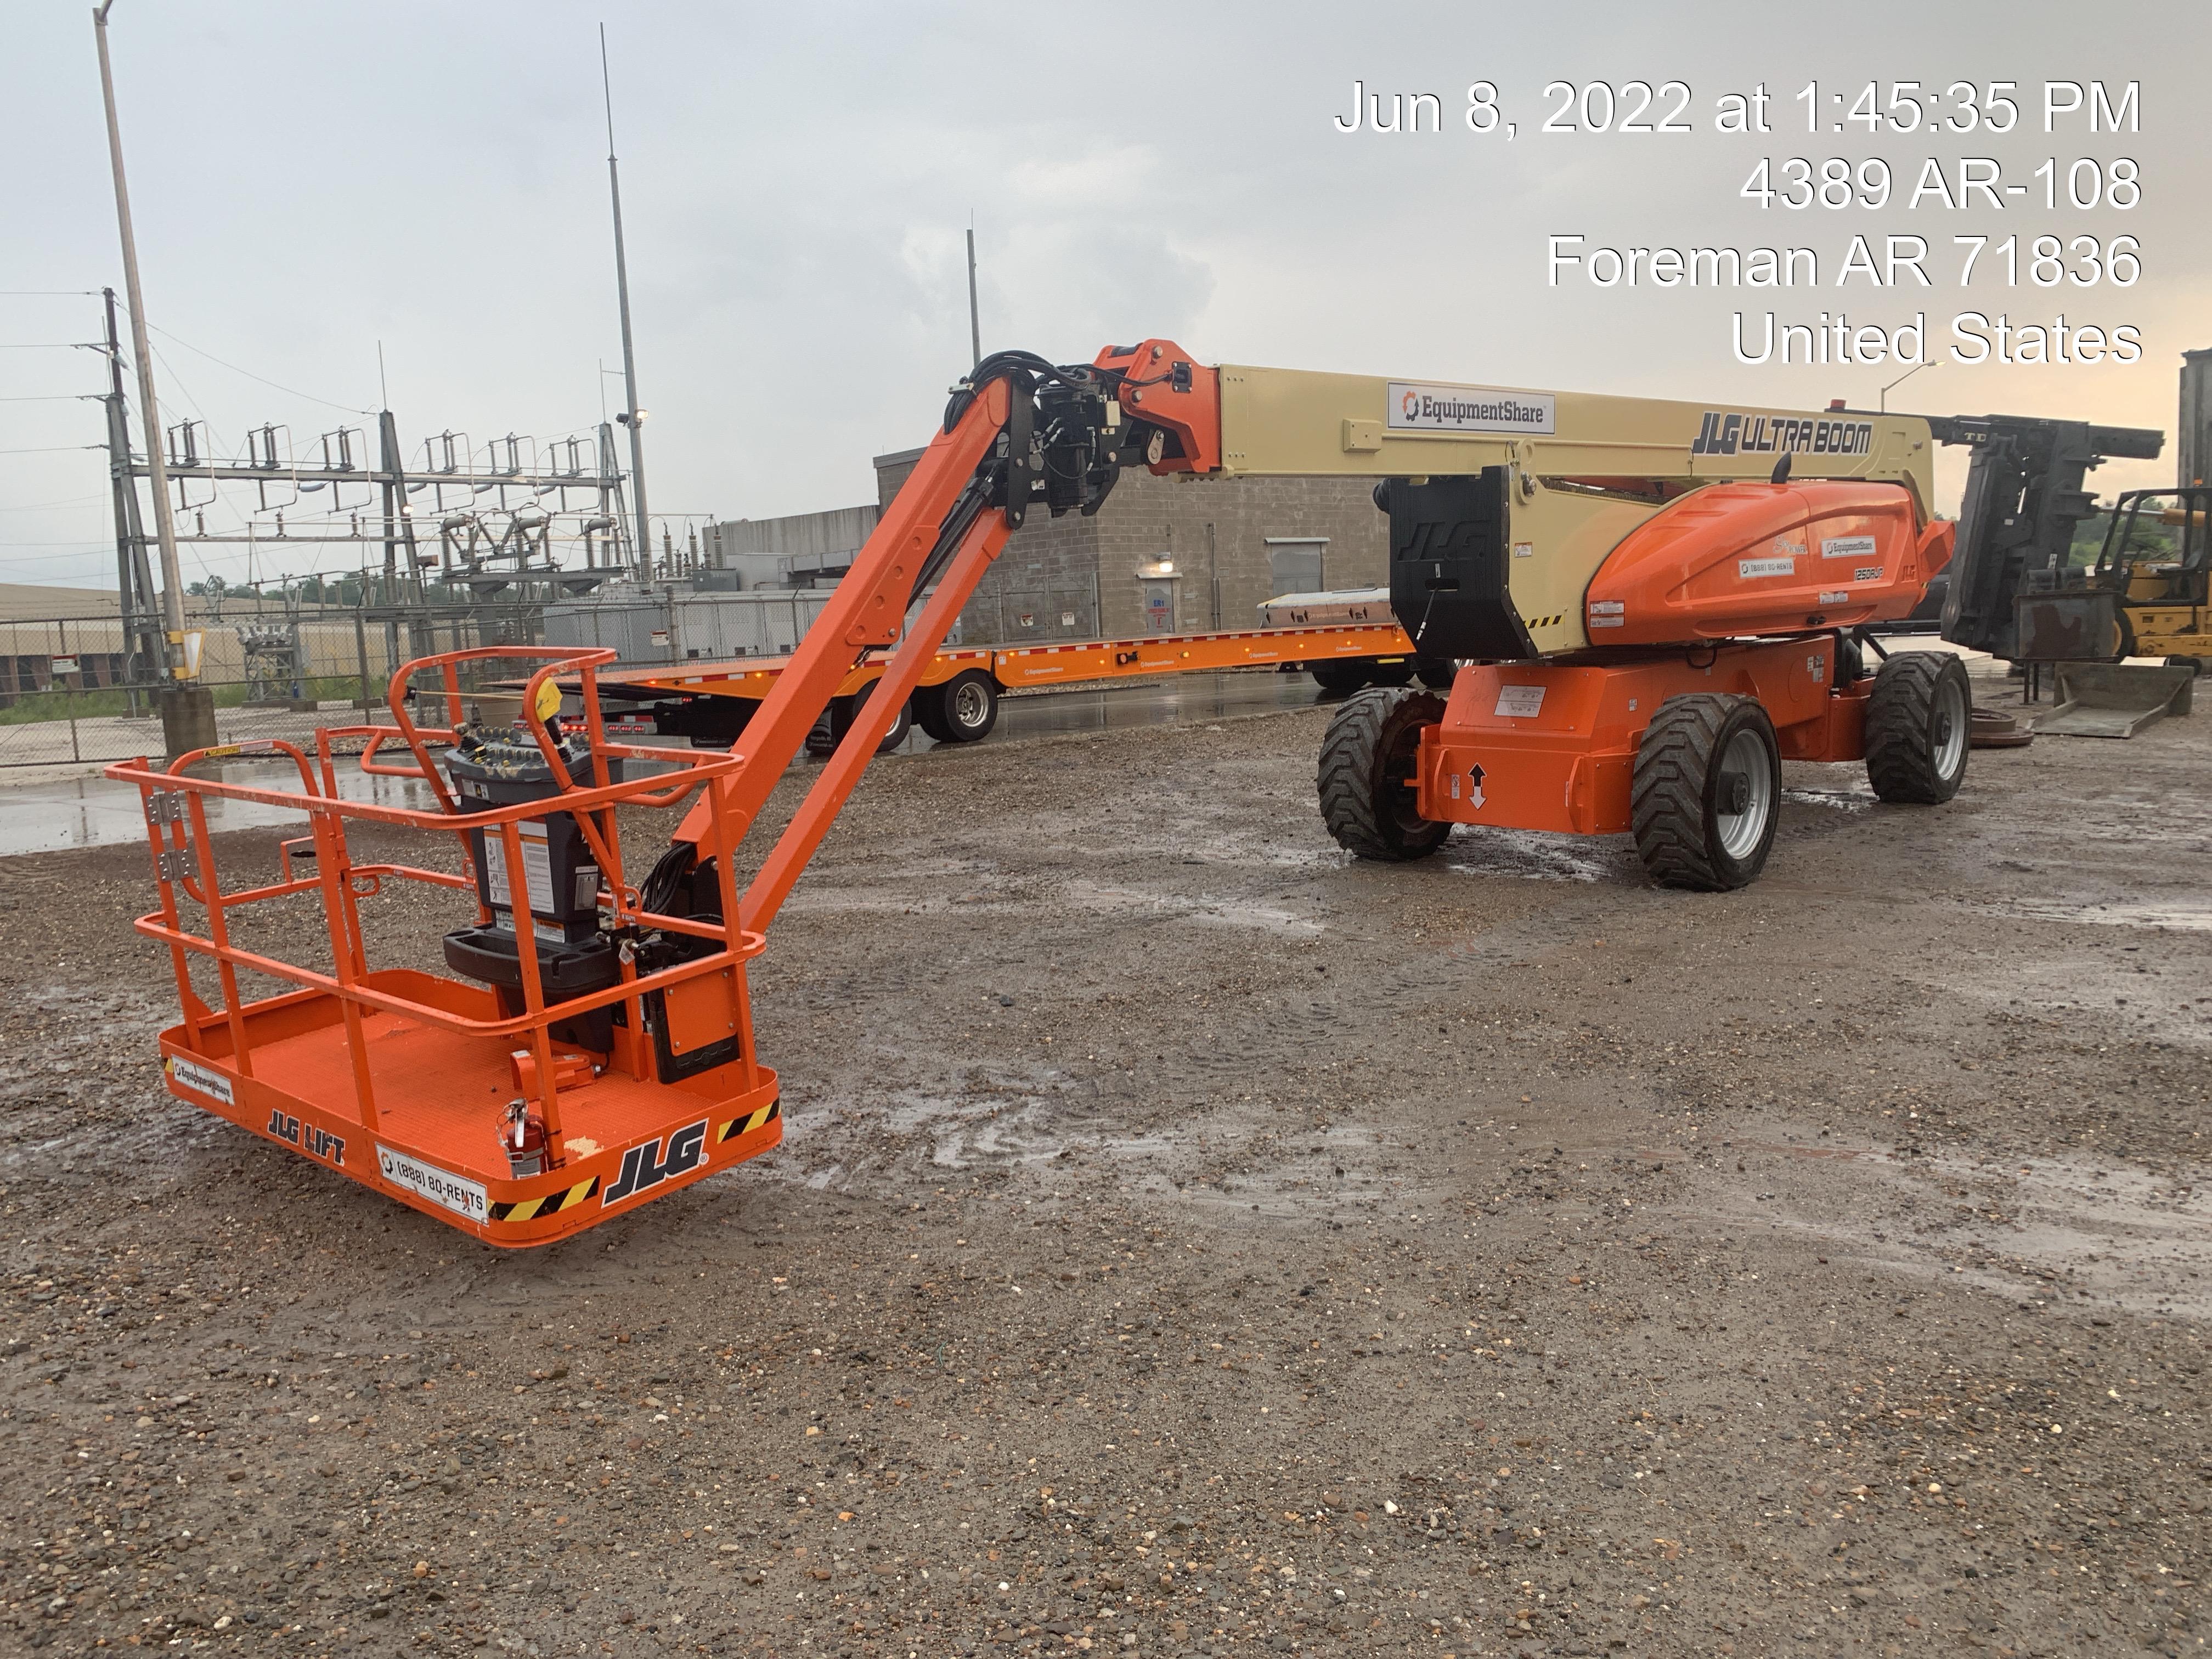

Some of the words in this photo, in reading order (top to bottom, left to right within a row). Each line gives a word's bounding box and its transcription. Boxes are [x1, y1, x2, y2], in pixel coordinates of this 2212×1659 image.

[1422, 396, 1543, 423] EquipmentShare
[1692, 413, 1742, 454] JLG
[1741, 417, 1813, 452] ULTRA
[1813, 421, 1872, 454] BOOM
[1833, 540, 1872, 555] EquipmentShare
[268, 1110, 300, 1144] JLG
[304, 1125, 345, 1164] LIFT
[603, 1119, 708, 1206] JLG
[397, 1161, 425, 1187] (888)
[428, 1176, 483, 1210] 80-RENTS
